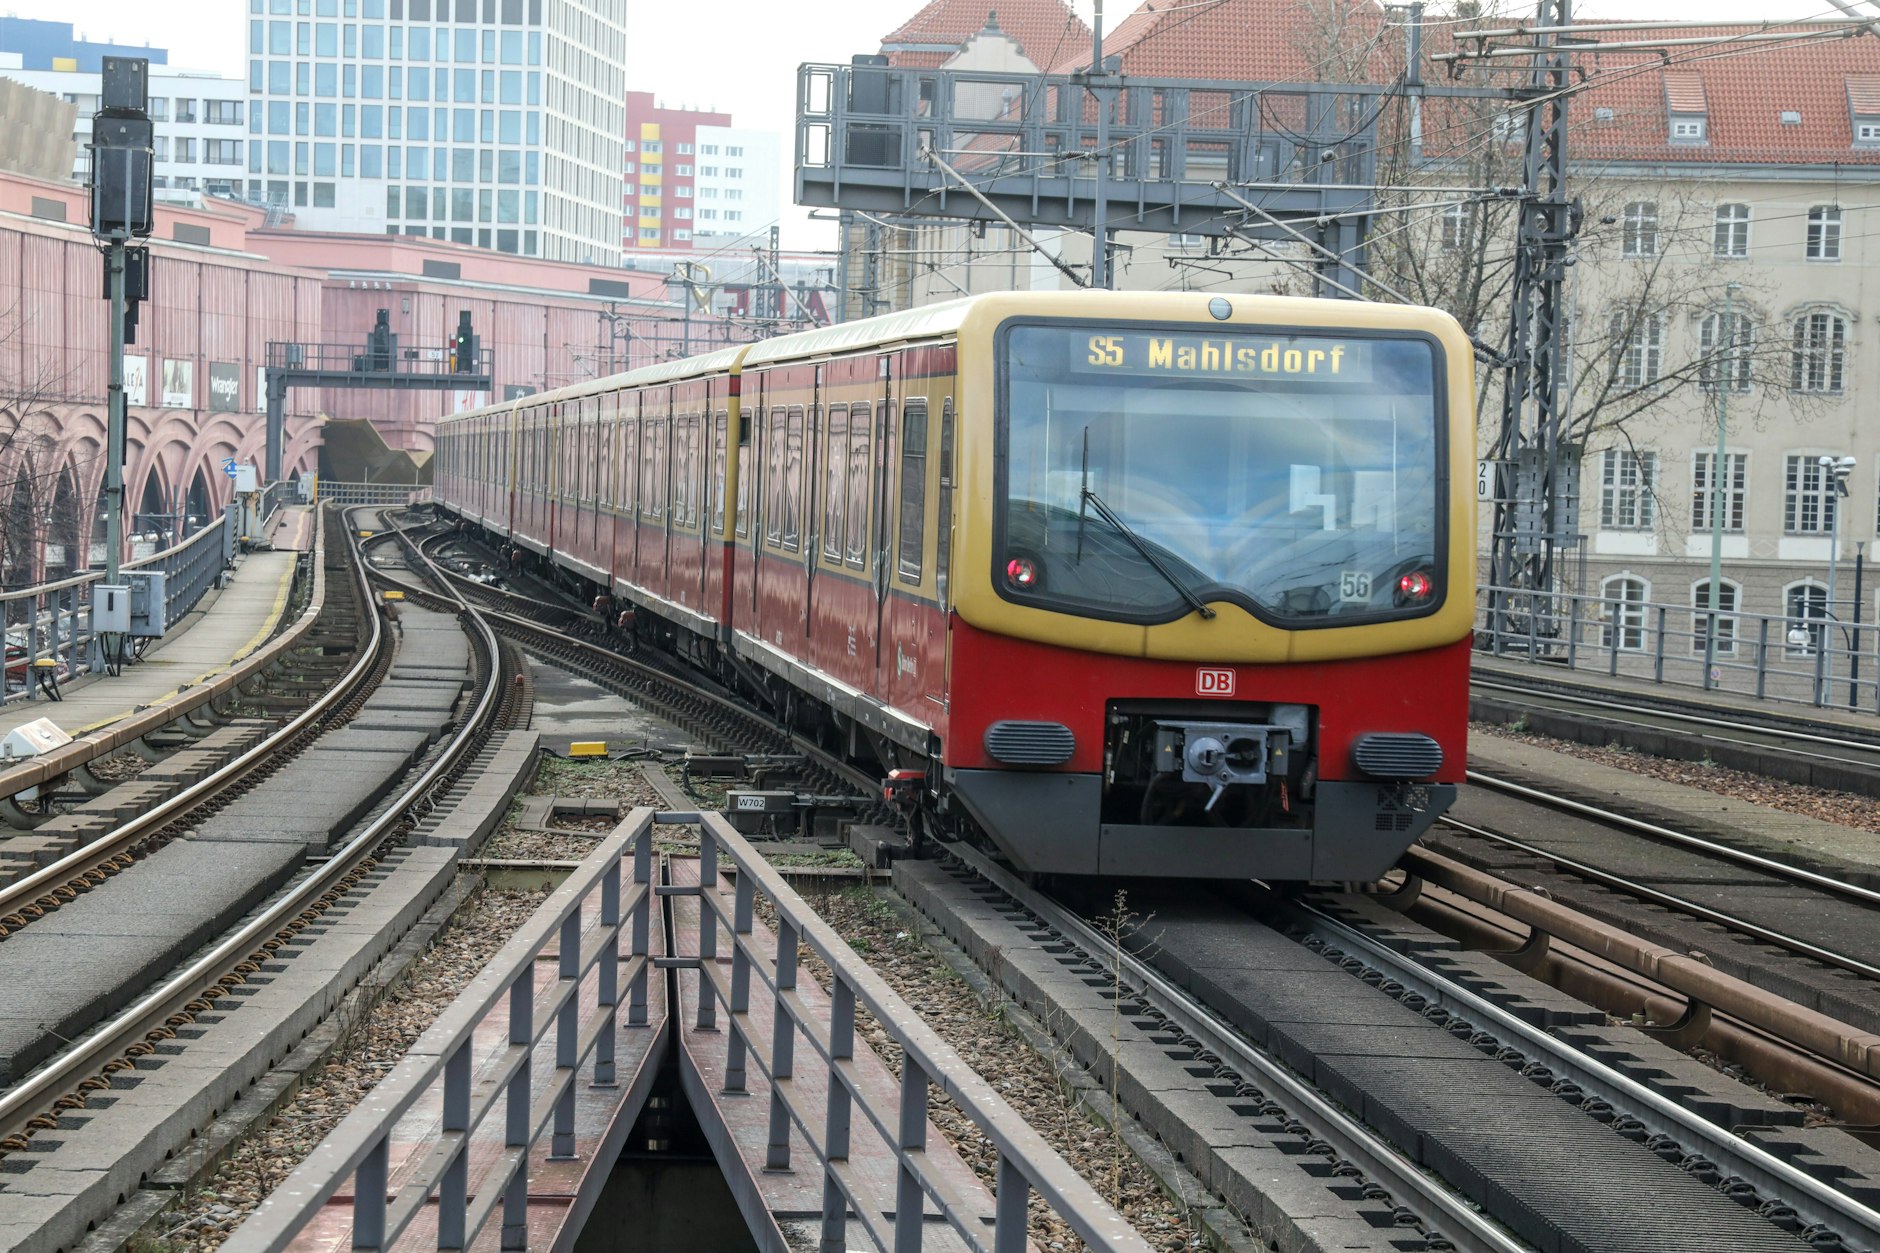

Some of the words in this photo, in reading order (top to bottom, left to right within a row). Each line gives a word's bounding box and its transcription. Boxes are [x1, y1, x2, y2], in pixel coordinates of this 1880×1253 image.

[1087, 336, 1125, 367] S5
[1148, 338, 1346, 374] Mahlsdorf
[211, 375, 239, 402] Wrangler
[1342, 573, 1369, 598] 56
[1201, 672, 1230, 691] DB
[738, 798, 765, 808] W702
